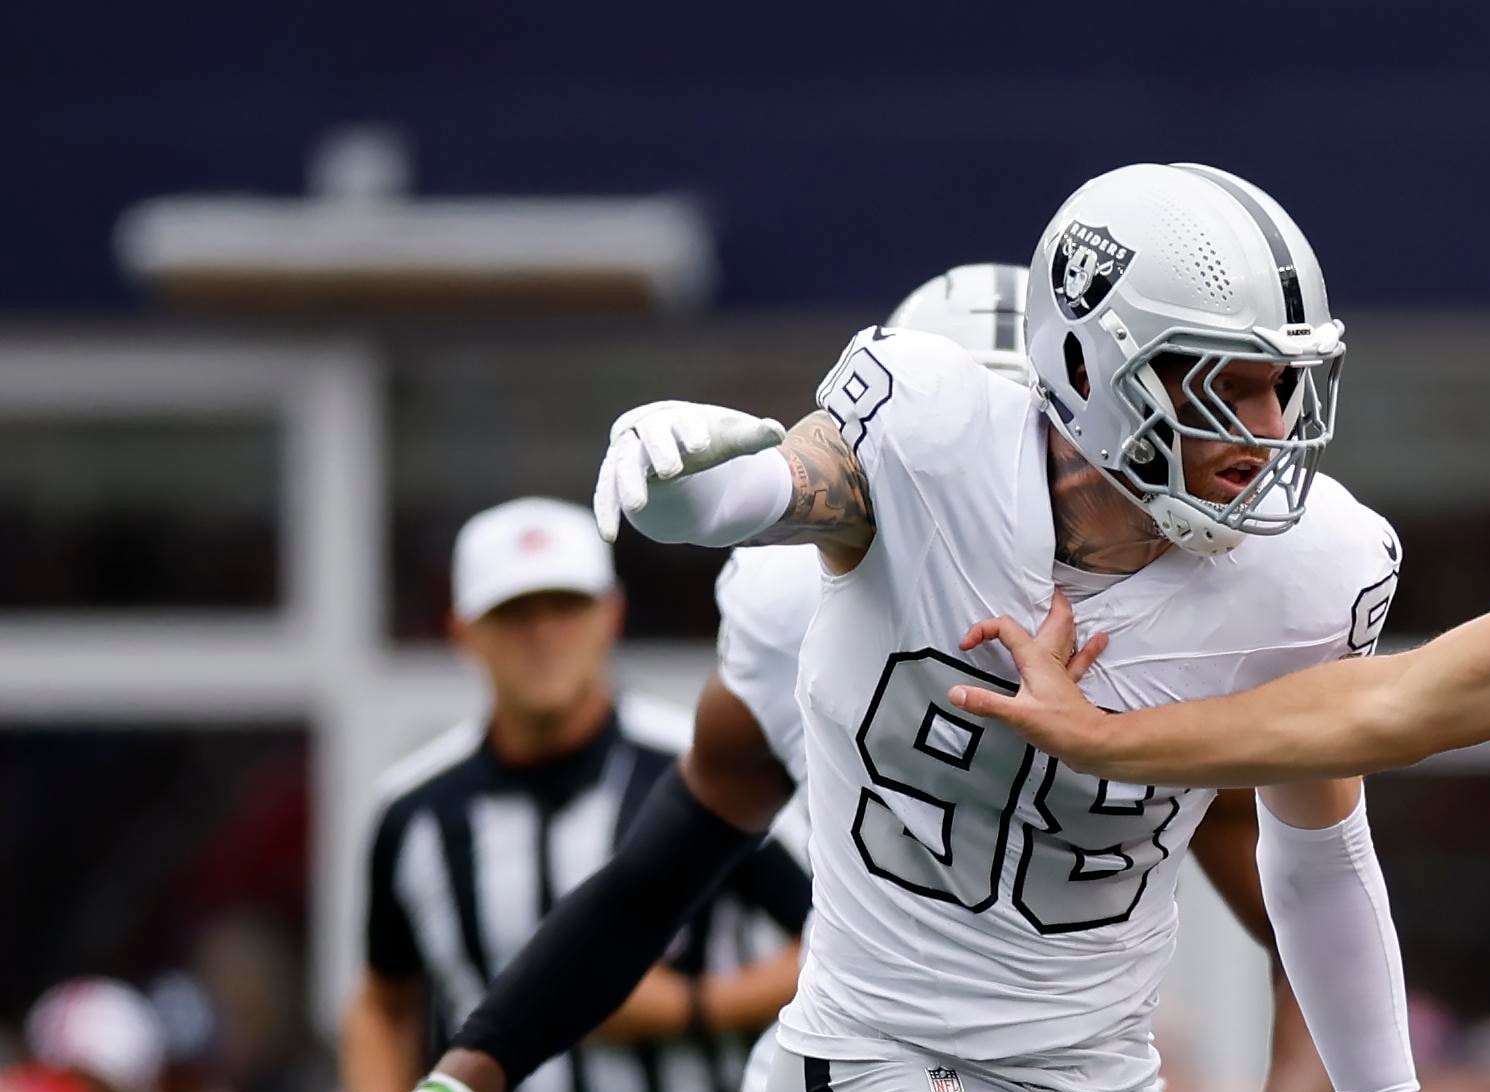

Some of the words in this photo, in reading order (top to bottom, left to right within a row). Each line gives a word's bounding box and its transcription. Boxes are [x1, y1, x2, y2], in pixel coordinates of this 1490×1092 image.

[1070, 223, 1127, 260] RAIDERS
[816, 333, 894, 456] 8
[850, 647, 1187, 935] 98
